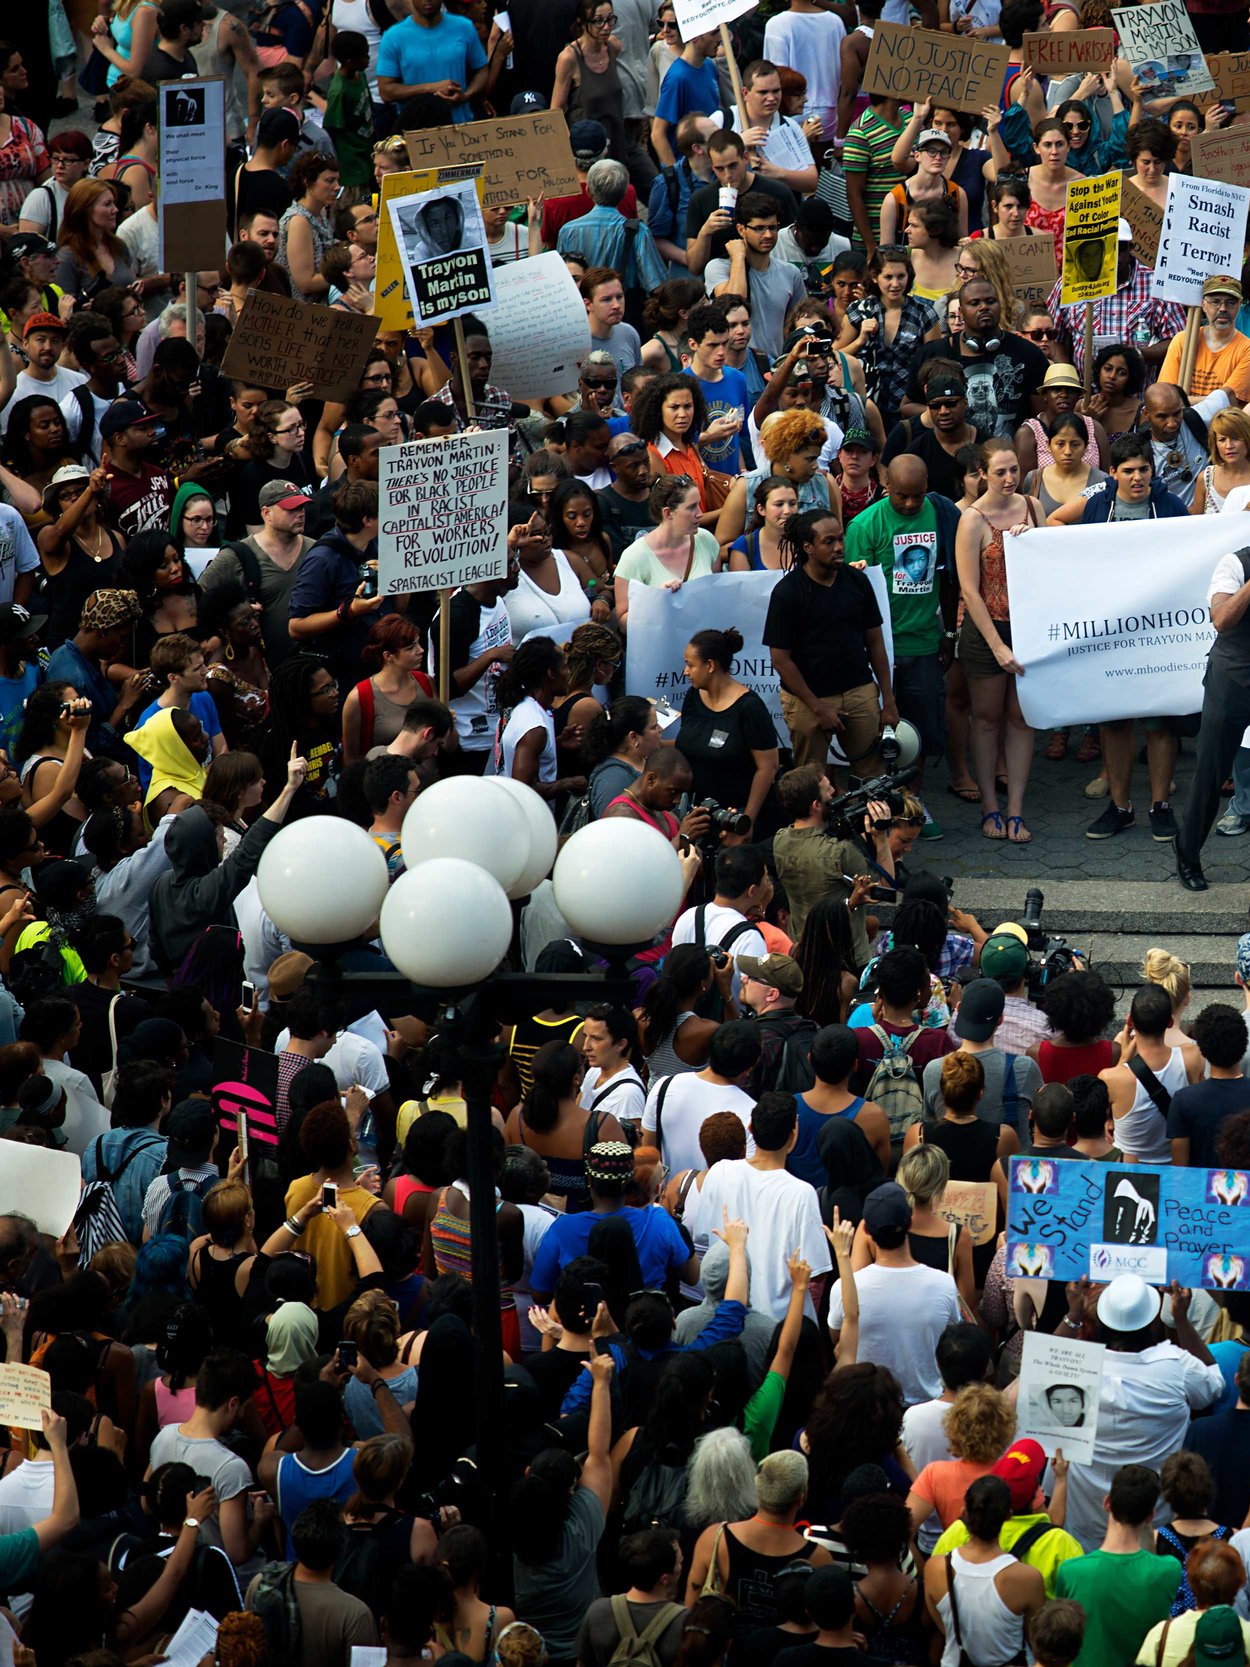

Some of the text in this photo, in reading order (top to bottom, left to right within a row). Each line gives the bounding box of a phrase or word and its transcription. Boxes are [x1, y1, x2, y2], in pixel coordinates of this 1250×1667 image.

[1113, 0, 1186, 28] TRAYVON
[1130, 20, 1184, 45] MARTIN
[876, 33, 1000, 78] NO JUSTICE
[1028, 38, 1114, 64] FREE MARISSA
[1125, 32, 1198, 61] IS MY SON
[873, 64, 980, 100] NO PEACE
[532, 119, 555, 135] FOR
[438, 167, 481, 178] ZIMMERMAN
[516, 167, 549, 181] FOR
[1070, 179, 1118, 197] Stop the War
[1181, 181, 1199, 191] From
[1201, 185, 1224, 195] Florida
[1069, 193, 1118, 213] Against Youth
[1189, 194, 1235, 218] Smash
[1092, 211, 1109, 221] Color
[1188, 216, 1231, 239] Racist
[1067, 224, 1099, 237] End Racial
[418, 253, 478, 279] Trayvon
[1181, 242, 1231, 267] Terror!
[427, 273, 475, 297] Martin
[251, 297, 282, 315] How
[286, 303, 303, 320] do
[335, 317, 353, 329] tell
[355, 324, 363, 333] a
[420, 300, 434, 315] is
[243, 314, 331, 347] MOTHER that
[277, 340, 357, 367] LIFE NOT
[247, 352, 347, 385] WORTH JUSTICE?
[387, 443, 501, 474] TRAYVON MARTIN:
[400, 437, 470, 457] REMEMBER
[385, 458, 499, 488] THERE'S NO JUSTICE
[390, 472, 498, 505] FOR BLACK PEOPLE
[383, 501, 505, 534] CAPITALIST AMERICA!
[408, 504, 420, 517] IN
[396, 520, 494, 552] FOR WORKERS
[895, 534, 935, 545] JUSTICE
[404, 533, 499, 568] REVOLUTION!
[388, 560, 501, 592] SPARTACIST LEAGUE
[1067, 633, 1192, 656] JUSTICE FOR TRAYVON
[1105, 661, 1208, 677] www.mhoodies.org
[1010, 1199, 1053, 1236] We
[1040, 1174, 1103, 1247] Stand
[1164, 1200, 1232, 1225] Peace
[1178, 1223, 1213, 1236] and
[1061, 1241, 1088, 1264] in
[1165, 1232, 1234, 1261] Prayer
[1116, 1257, 1147, 1268] MCC
[1080, 1367, 1098, 1375] System
